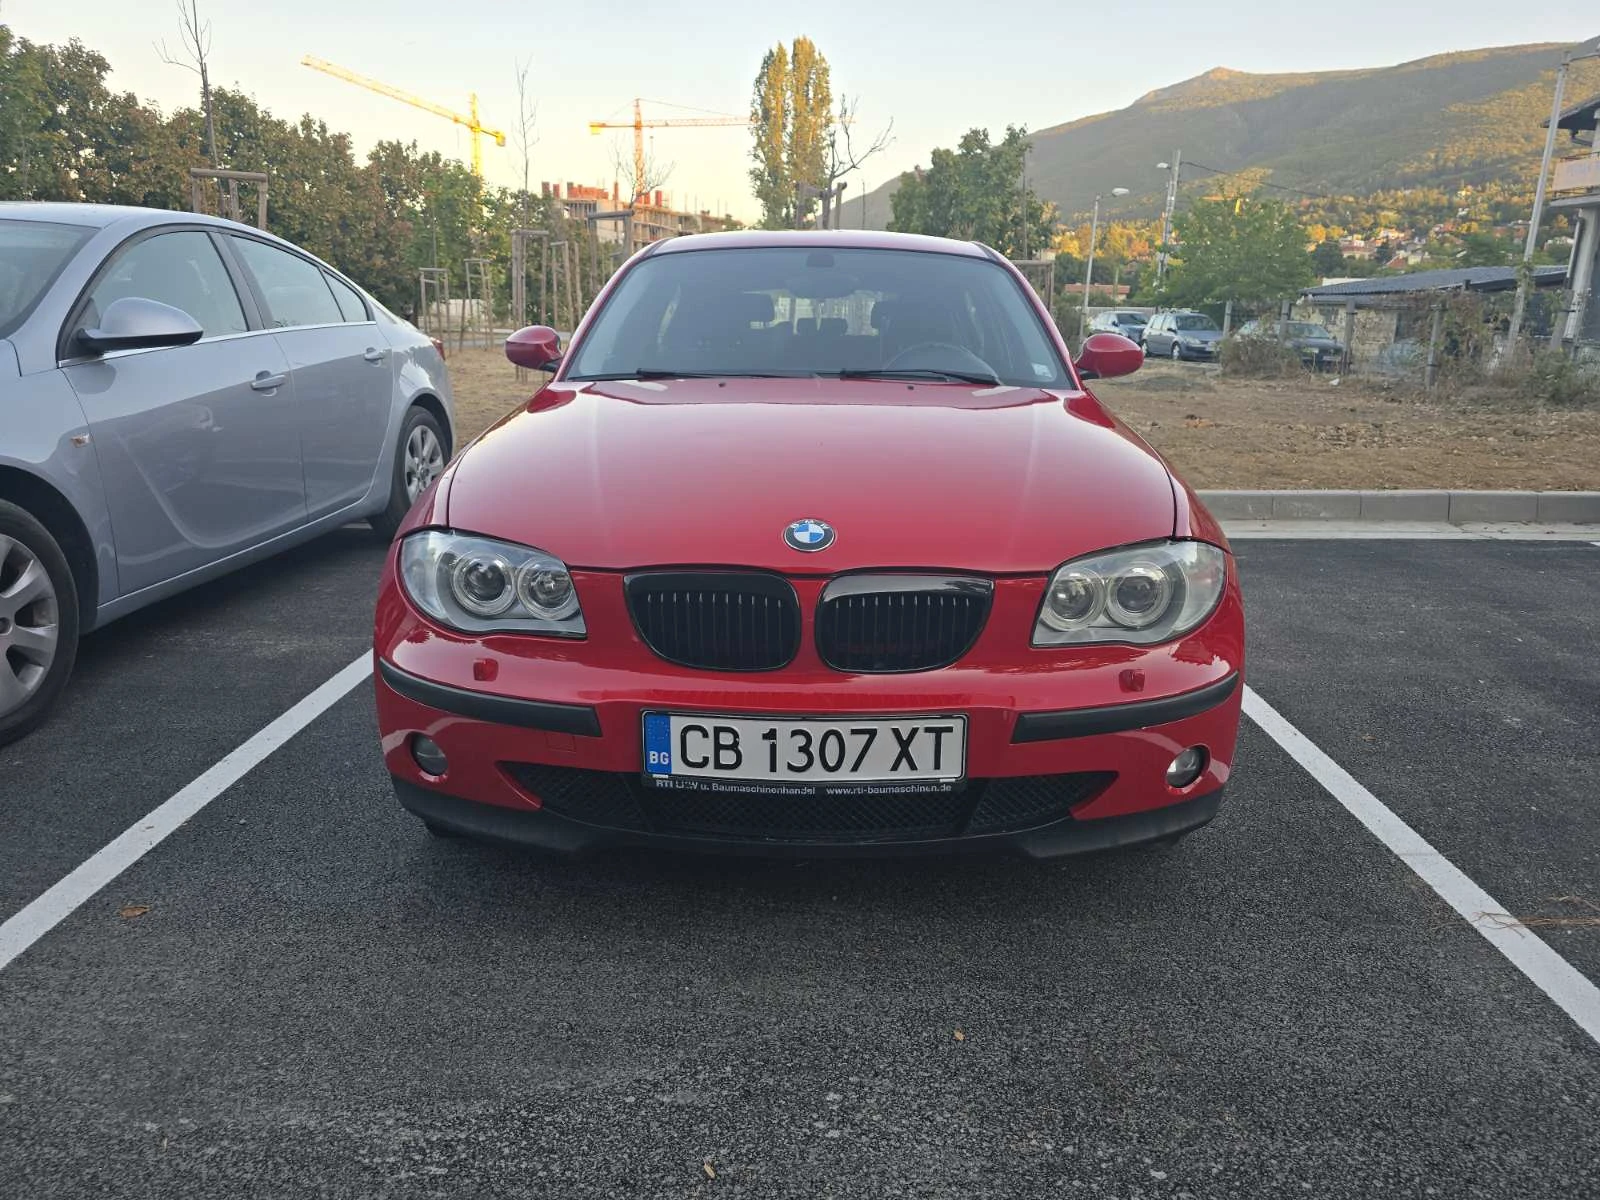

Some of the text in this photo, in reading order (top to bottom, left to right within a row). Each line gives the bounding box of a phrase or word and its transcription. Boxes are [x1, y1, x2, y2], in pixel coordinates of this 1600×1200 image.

[649, 751, 669, 765] BG
[680, 724, 954, 773] CB 1307 XT
